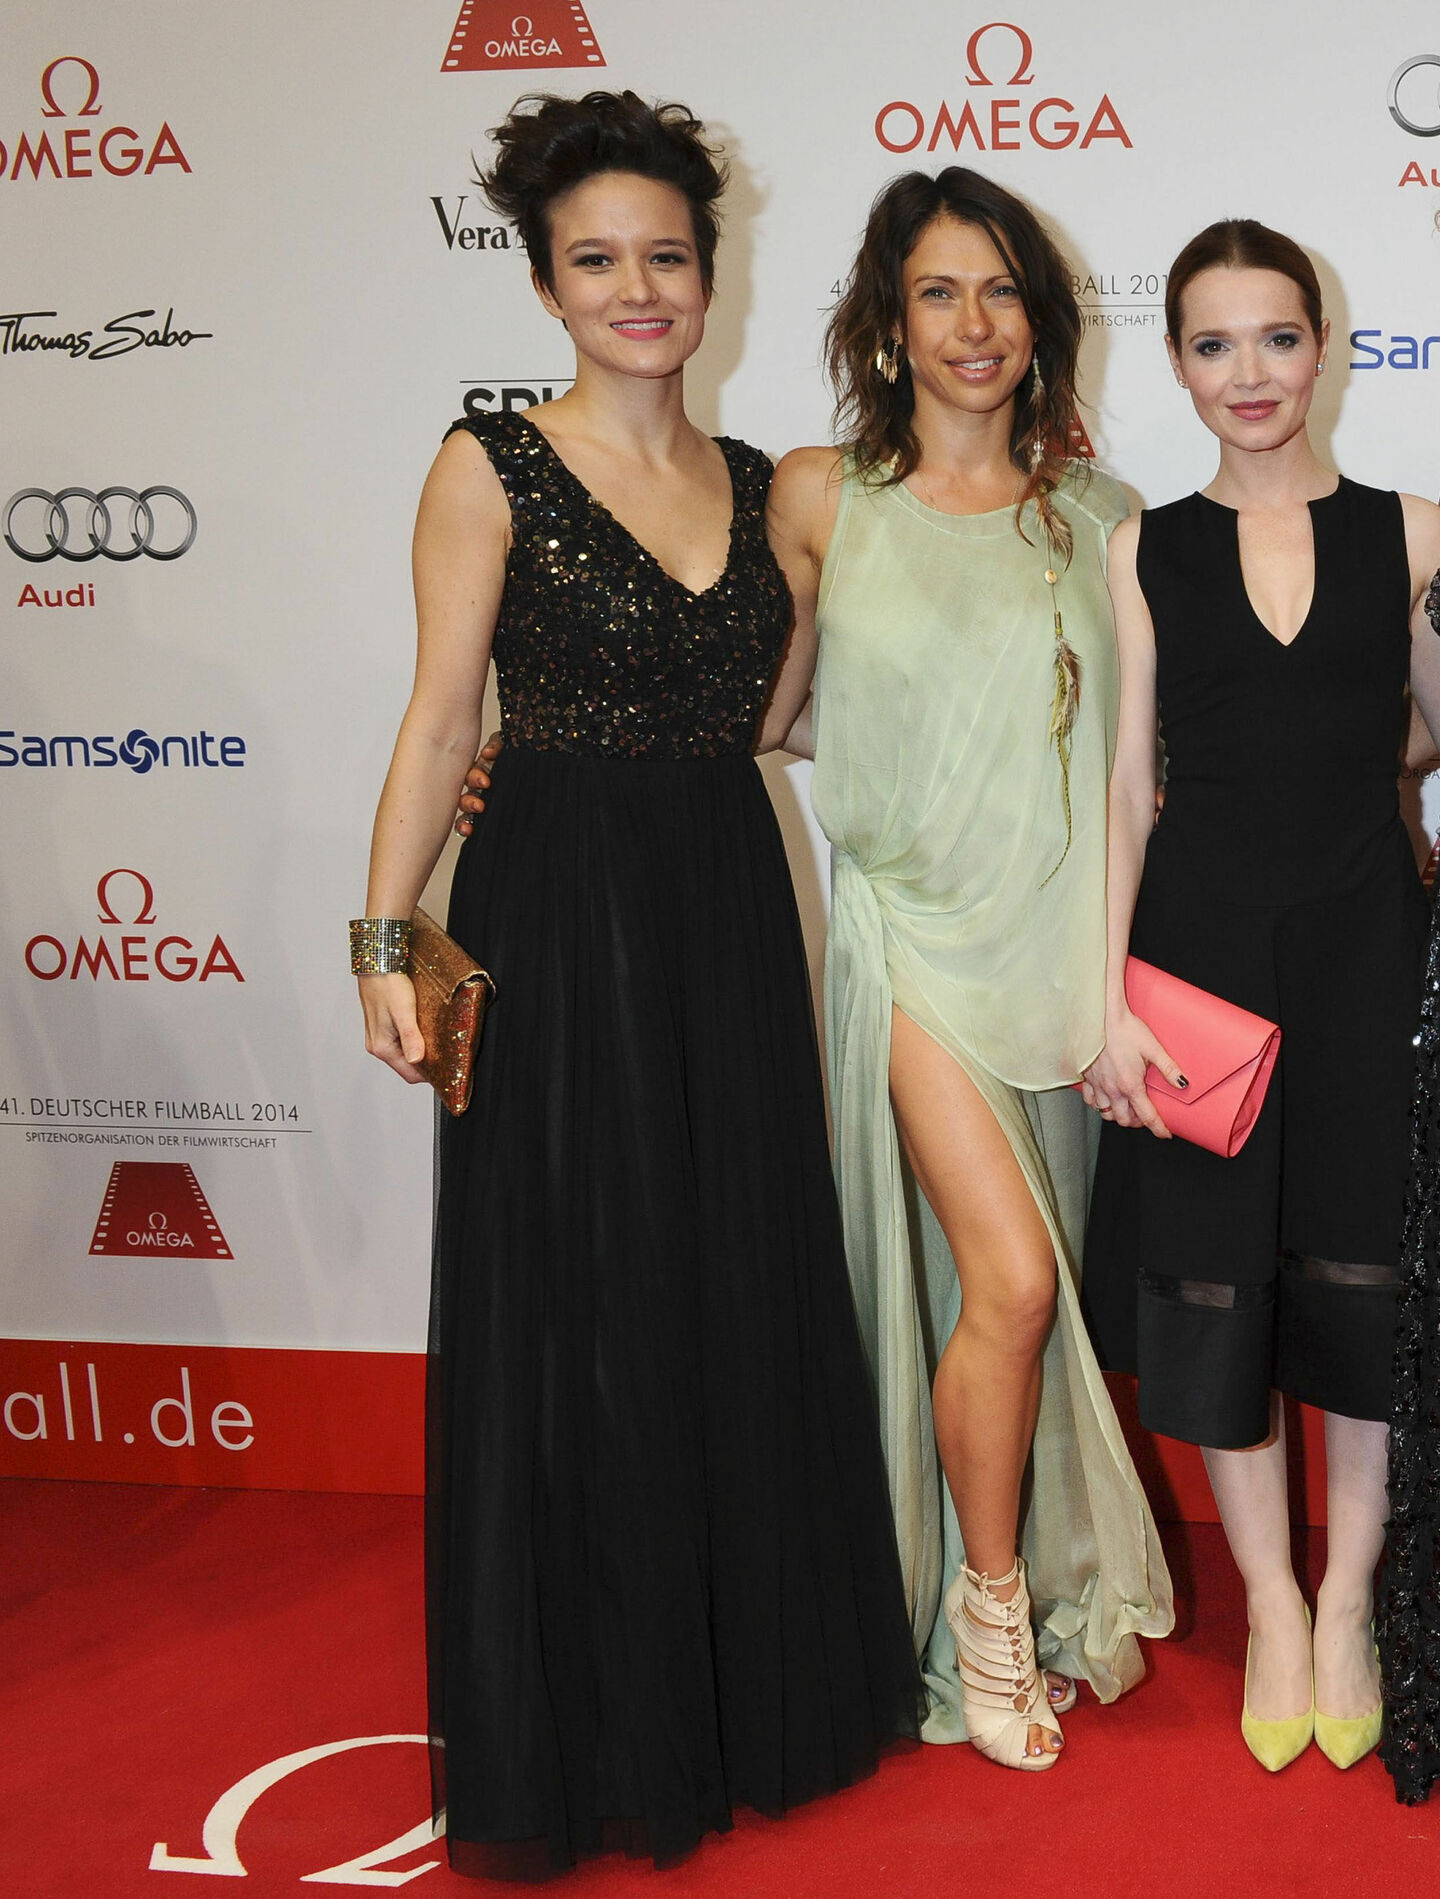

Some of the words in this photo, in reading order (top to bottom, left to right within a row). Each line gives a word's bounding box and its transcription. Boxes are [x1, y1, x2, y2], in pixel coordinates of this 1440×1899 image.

[485, 38, 562, 58] OMEGA
[875, 93, 1133, 154] OMEGA
[0, 122, 192, 181] MEGA
[429, 195, 511, 251] Vera
[1130, 274, 1168, 295] 201
[0, 311, 93, 358] Thomas
[88, 308, 213, 360] Sabo
[17, 583, 95, 608] Audi
[24, 934, 246, 983] OMEGA
[0, 1098, 24, 1115] 41.
[30, 1098, 148, 1118] DEUTSCHER
[154, 1101, 245, 1121] FILMBALL
[252, 1103, 299, 1122] 2014
[25, 1131, 155, 1146] SPITZENORGANISATION
[158, 1135, 180, 1147] DER
[183, 1135, 277, 1148] FILMWIRTSCHAFT
[126, 1231, 195, 1248] OMEGA
